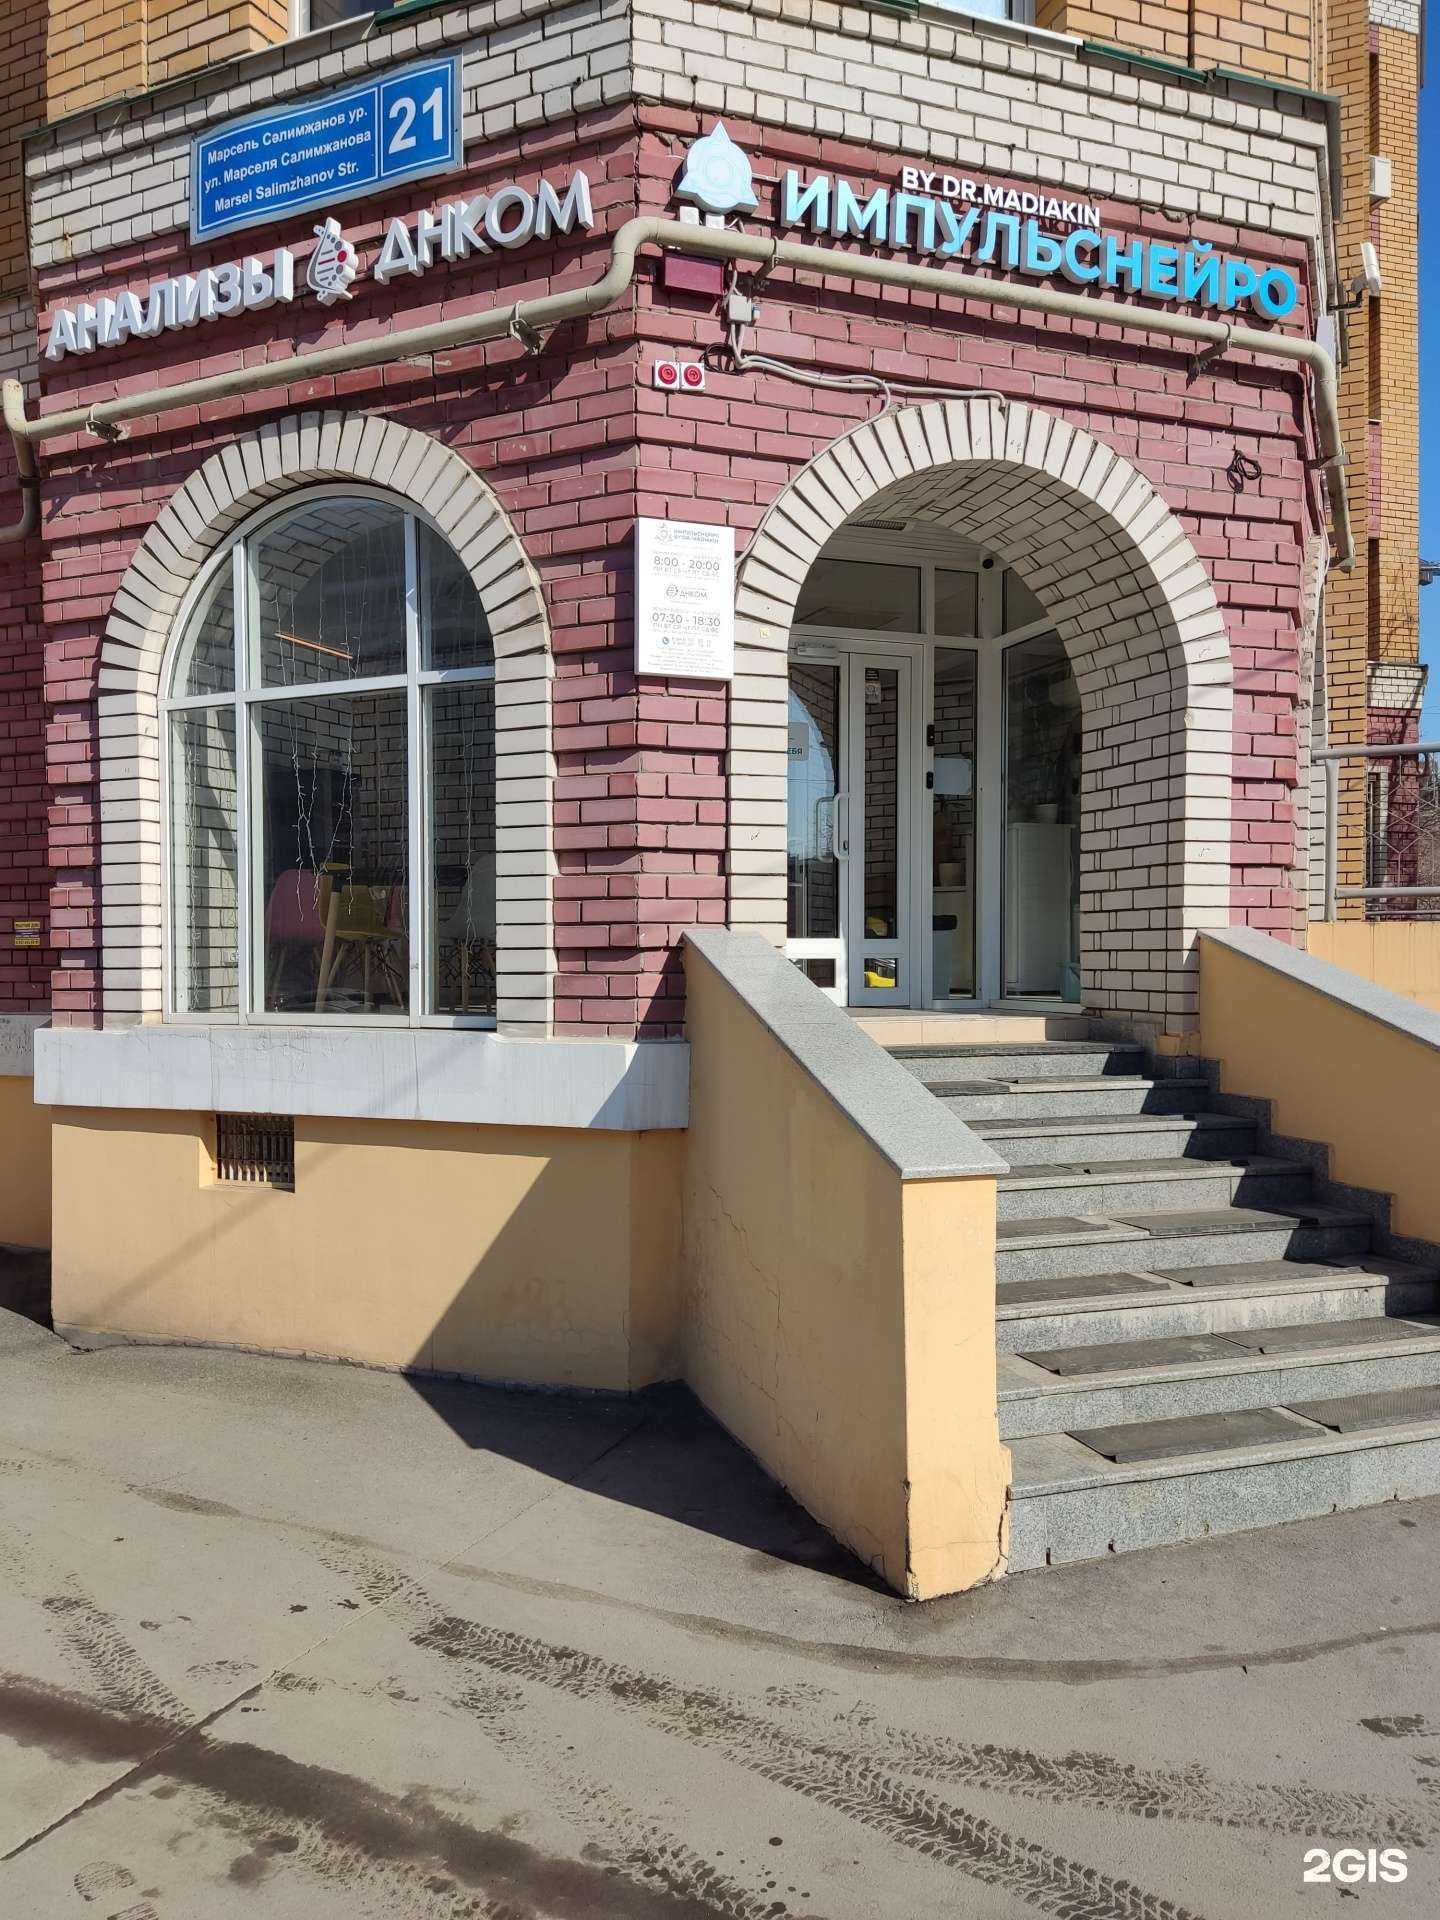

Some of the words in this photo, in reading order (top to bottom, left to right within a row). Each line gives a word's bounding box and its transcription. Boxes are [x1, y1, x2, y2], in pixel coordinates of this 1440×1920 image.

[207, 139, 259, 166] Марсель
[262, 112, 346, 147] Сәлимҗанов
[348, 105, 368, 125] ур.
[388, 86, 443, 155] 21
[204, 176, 221, 194] ул.
[223, 157, 278, 185] Марселя
[280, 130, 372, 166] Салимжанова
[214, 192, 252, 213] Marsel
[255, 168, 334, 200] Salimzhanov
[337, 158, 360, 178] Str.
[902, 165, 936, 194] BY
[374, 168, 594, 285] ДНКОМ
[781, 168, 1298, 321] ИМПУЛЬСНЕЙРО
[45, 247, 294, 361] АНАЛИЗЫ
[654, 555, 679, 567] 8:00
[689, 559, 720, 571] 20:00
[652, 612, 683, 624] 07:30
[693, 615, 720, 627] 18:30
[787, 747, 803, 755] ЕБЯ
